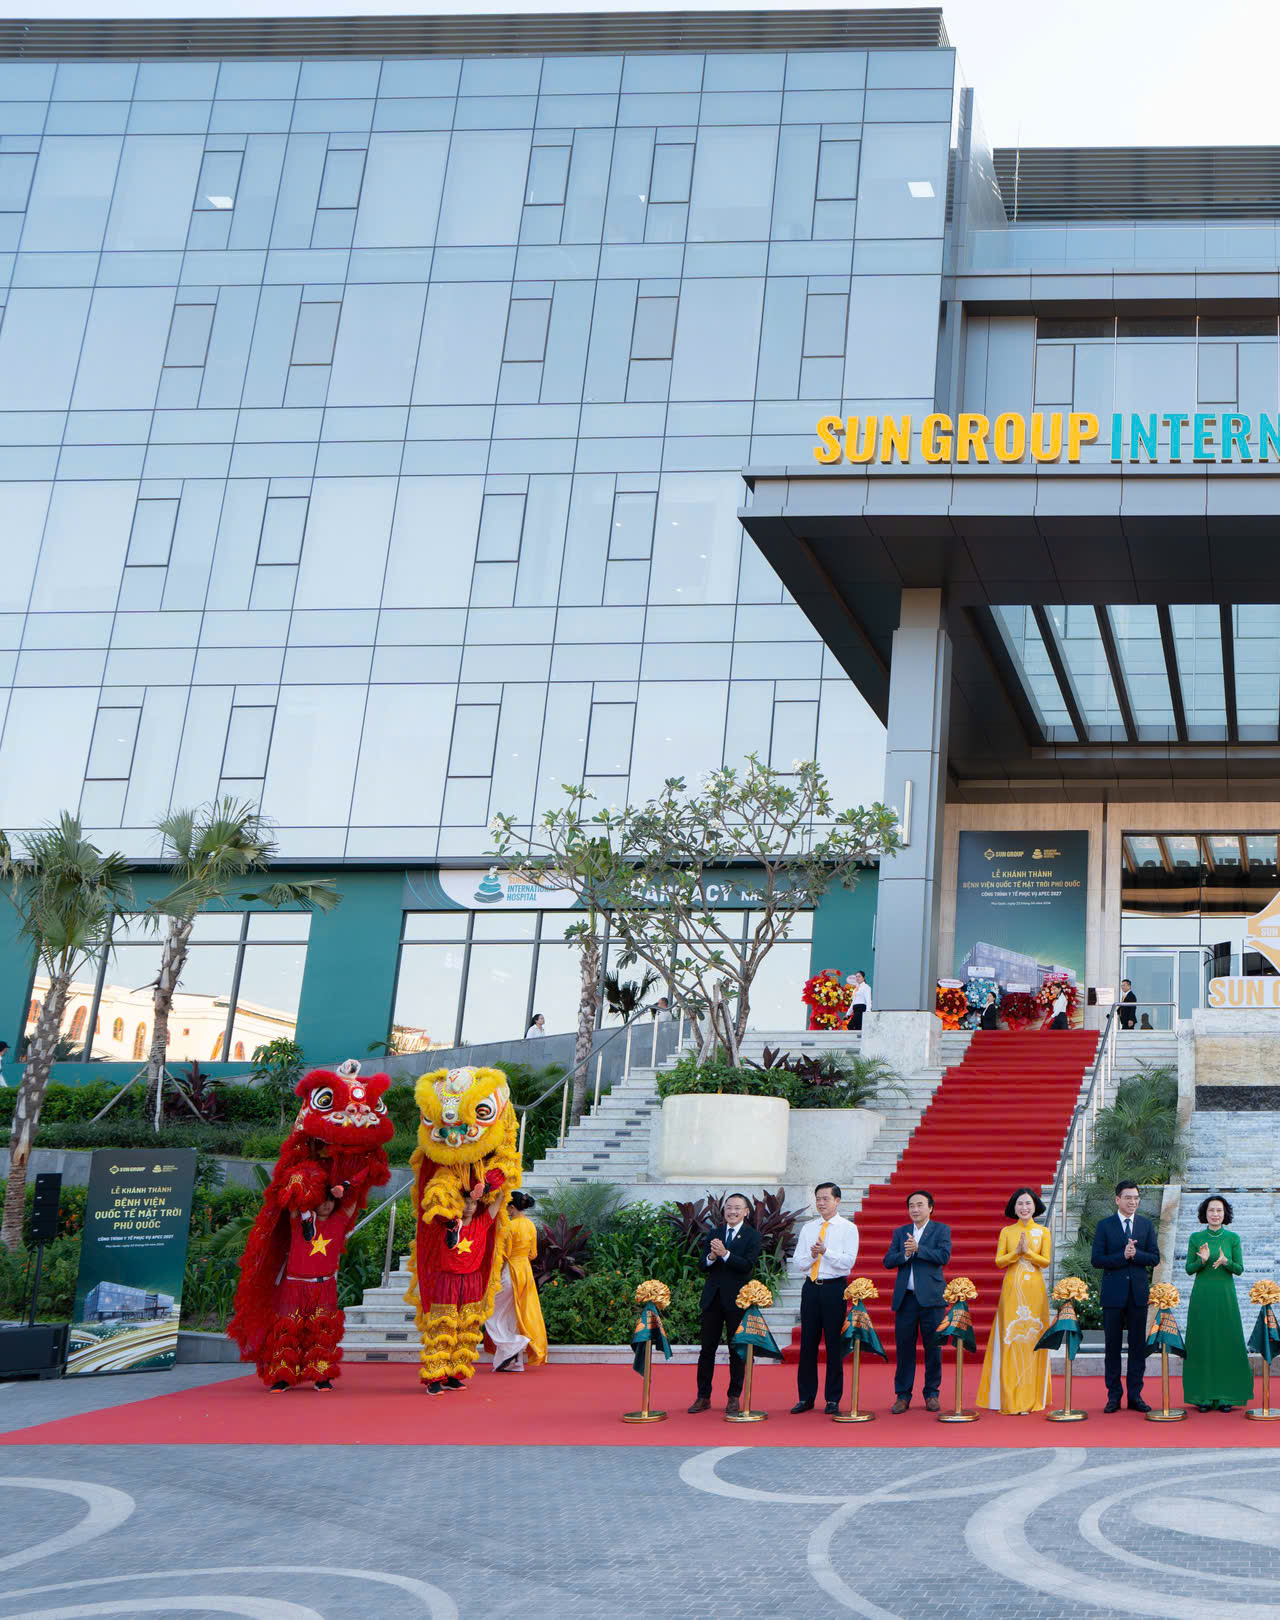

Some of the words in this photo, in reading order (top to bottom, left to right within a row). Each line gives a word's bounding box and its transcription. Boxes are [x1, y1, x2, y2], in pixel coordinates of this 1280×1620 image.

[814, 416, 912, 464] SUN
[921, 412, 1099, 464] GROUP
[1002, 870, 1026, 878] KHÁNH
[1028, 870, 1052, 878] THÀNH
[507, 893, 536, 901] HOSPITAL
[1261, 928, 1278, 936] SUN
[1210, 979, 1265, 1006] SUN
[114, 1198, 141, 1208] BỆNH
[144, 1197, 166, 1208] VIỆN
[95, 1207, 120, 1220] QUỐC
[124, 1208, 137, 1218] TẾ
[138, 1208, 158, 1220] MẶT
[160, 1207, 182, 1217] TRỜI
[114, 1220, 133, 1230] PHÚ
[136, 1218, 161, 1230] QUỐC
